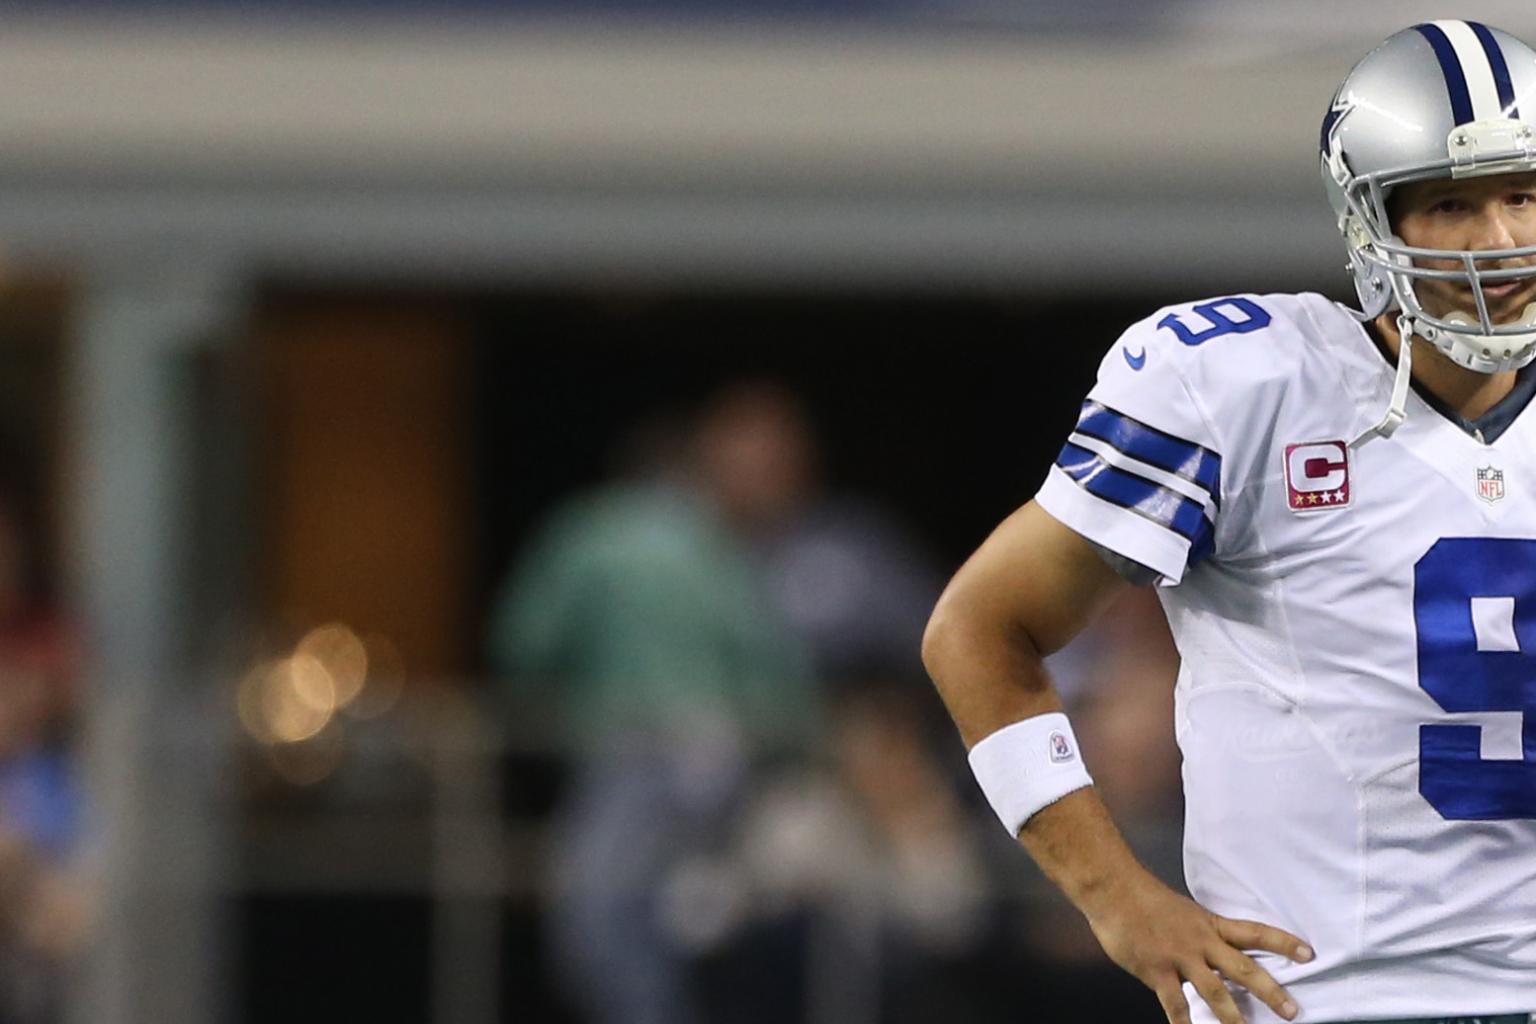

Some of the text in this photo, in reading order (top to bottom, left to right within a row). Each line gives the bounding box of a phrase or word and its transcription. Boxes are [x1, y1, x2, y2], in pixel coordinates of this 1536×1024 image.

[1156, 297, 1272, 346] 9
[1289, 443, 1347, 493] C
[1479, 480, 1504, 498] NFL
